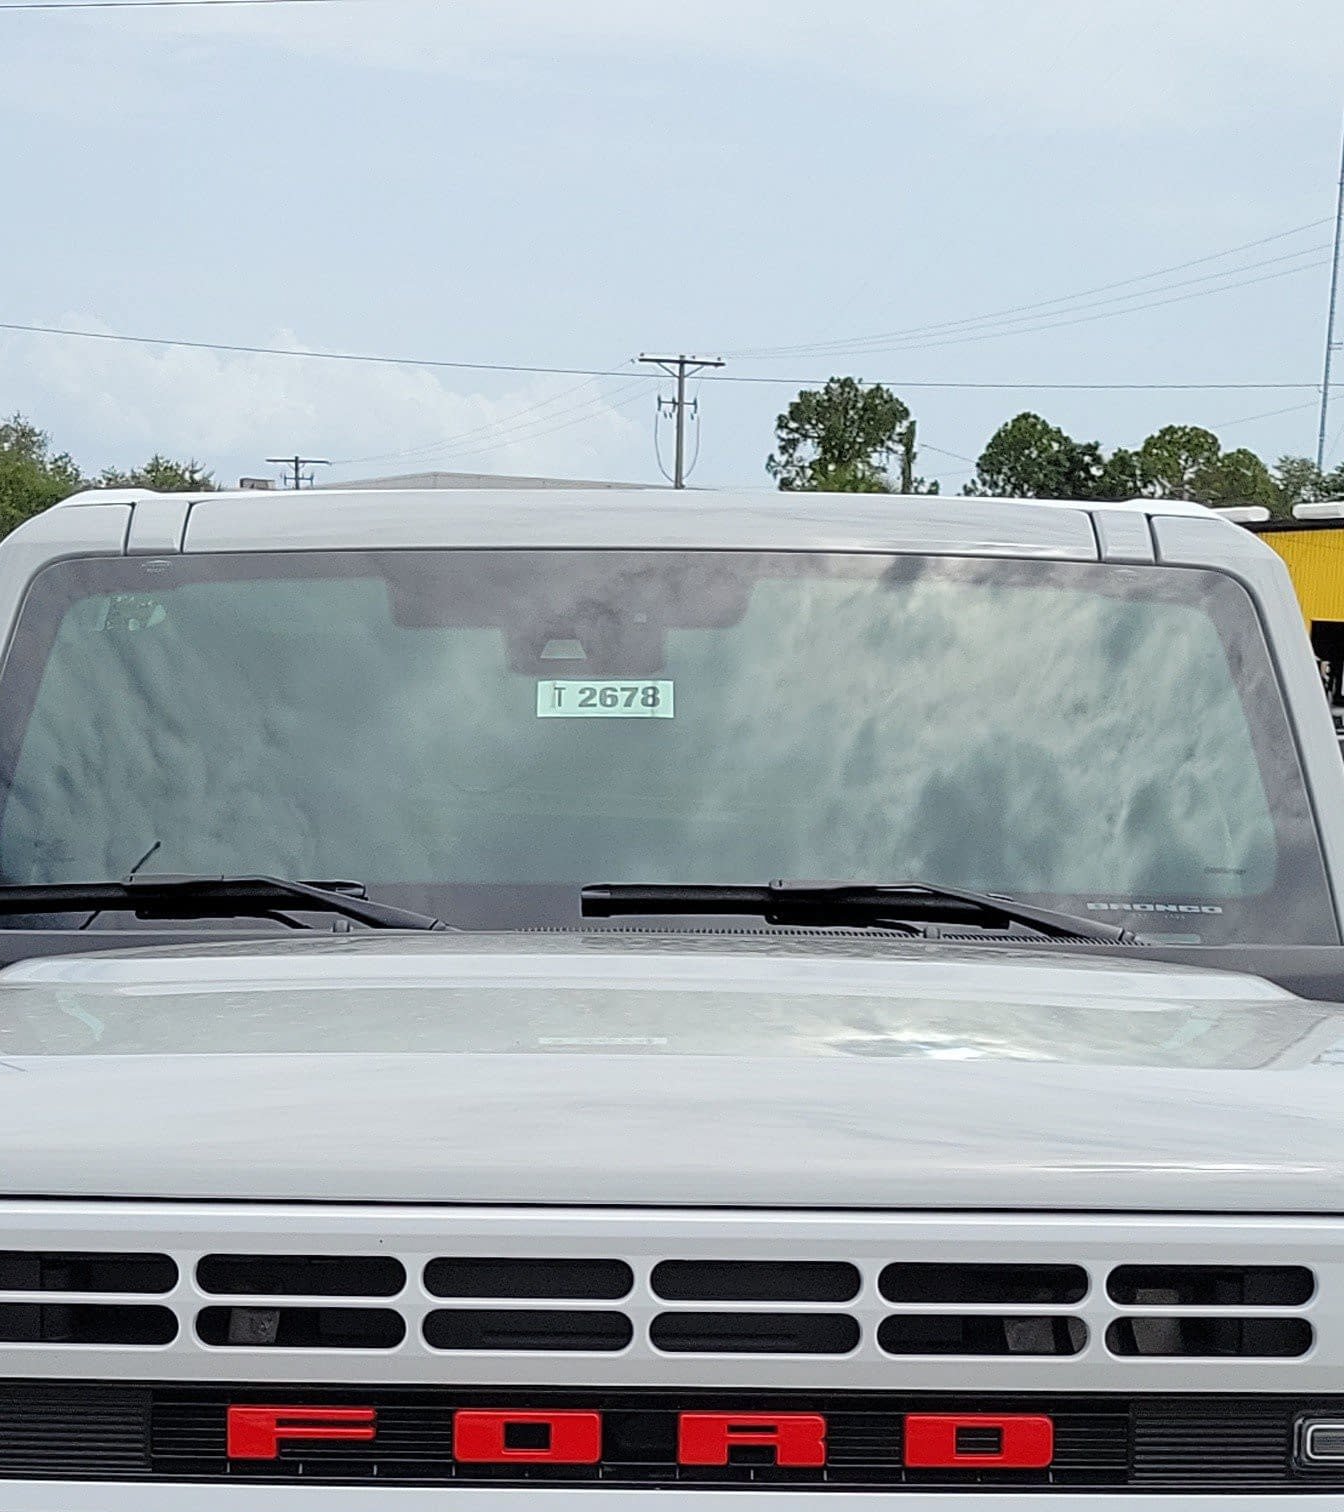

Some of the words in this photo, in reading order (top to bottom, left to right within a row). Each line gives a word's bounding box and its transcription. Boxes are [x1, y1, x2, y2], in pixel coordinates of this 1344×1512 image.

[578, 686, 661, 708] 2678
[1086, 902, 1223, 914] BRONCO
[227, 1406, 1054, 1469] FORD
